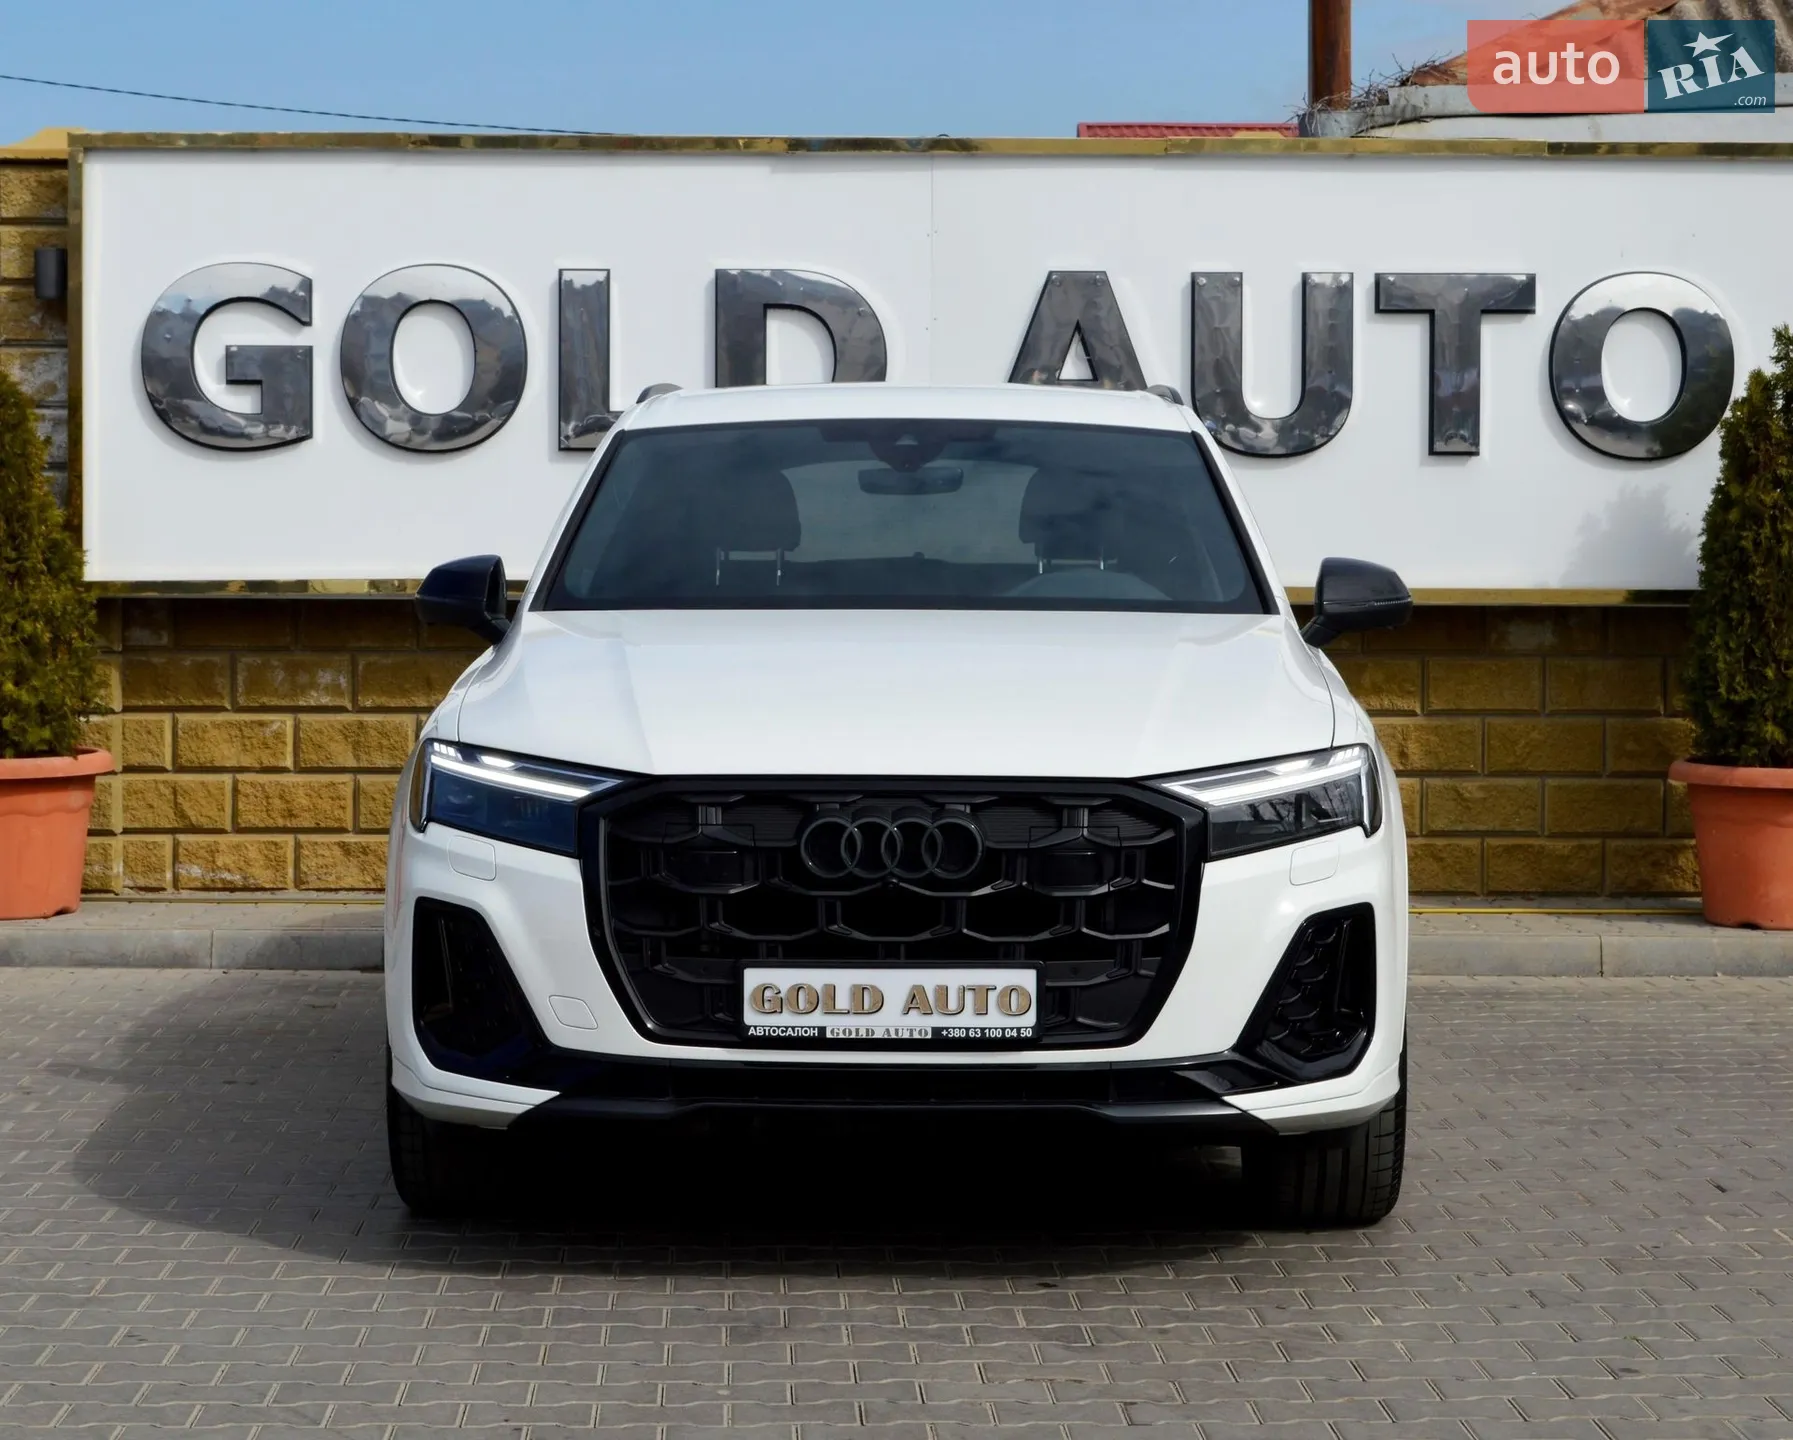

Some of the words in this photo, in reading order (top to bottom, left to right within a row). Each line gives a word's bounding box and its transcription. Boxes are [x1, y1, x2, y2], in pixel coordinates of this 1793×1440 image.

[140, 261, 888, 455] GOLD
[1008, 270, 1736, 461] AUTO
[749, 983, 885, 1015] GOLD
[902, 984, 1032, 1016] AUTO
[748, 1026, 818, 1037] АВТОСАЛОН
[830, 1027, 876, 1037] GOLD
[881, 1027, 929, 1038] AUTO
[941, 1028, 966, 1038] +380
[968, 1028, 982, 1038] 63
[984, 1028, 1002, 1038] 100
[1004, 1028, 1018, 1038] 04
[1019, 1028, 1033, 1037] 50
